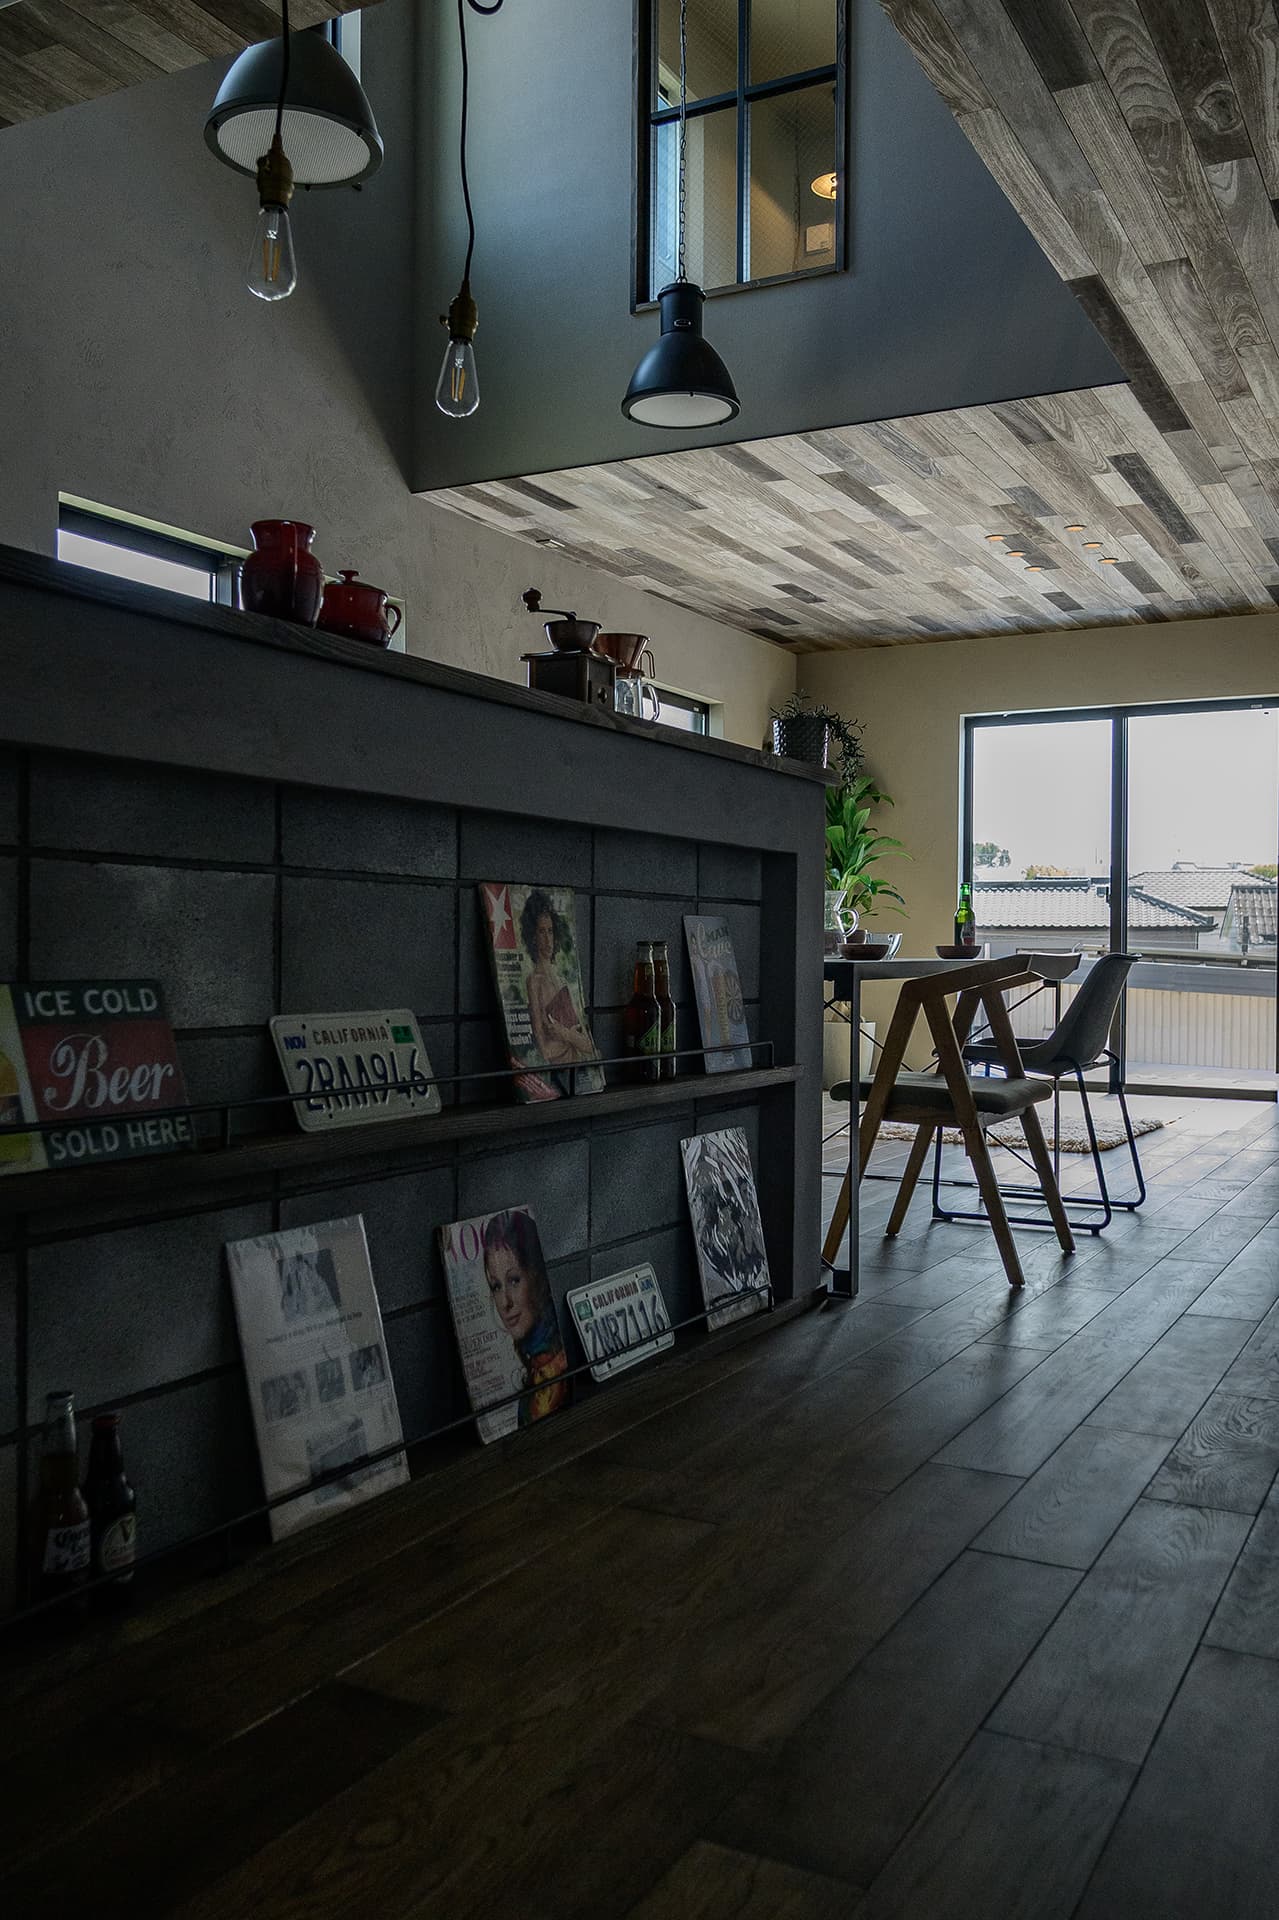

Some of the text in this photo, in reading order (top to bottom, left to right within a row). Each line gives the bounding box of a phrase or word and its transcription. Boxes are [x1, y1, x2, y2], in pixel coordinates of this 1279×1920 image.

[24, 988, 158, 1017] ICE COLD
[313, 1026, 389, 1045] CALIFORNIA
[43, 1033, 174, 1111] Beer
[51, 1116, 191, 1160] SOLD HERE
[592, 1281, 639, 1309] CALIFORNIA
